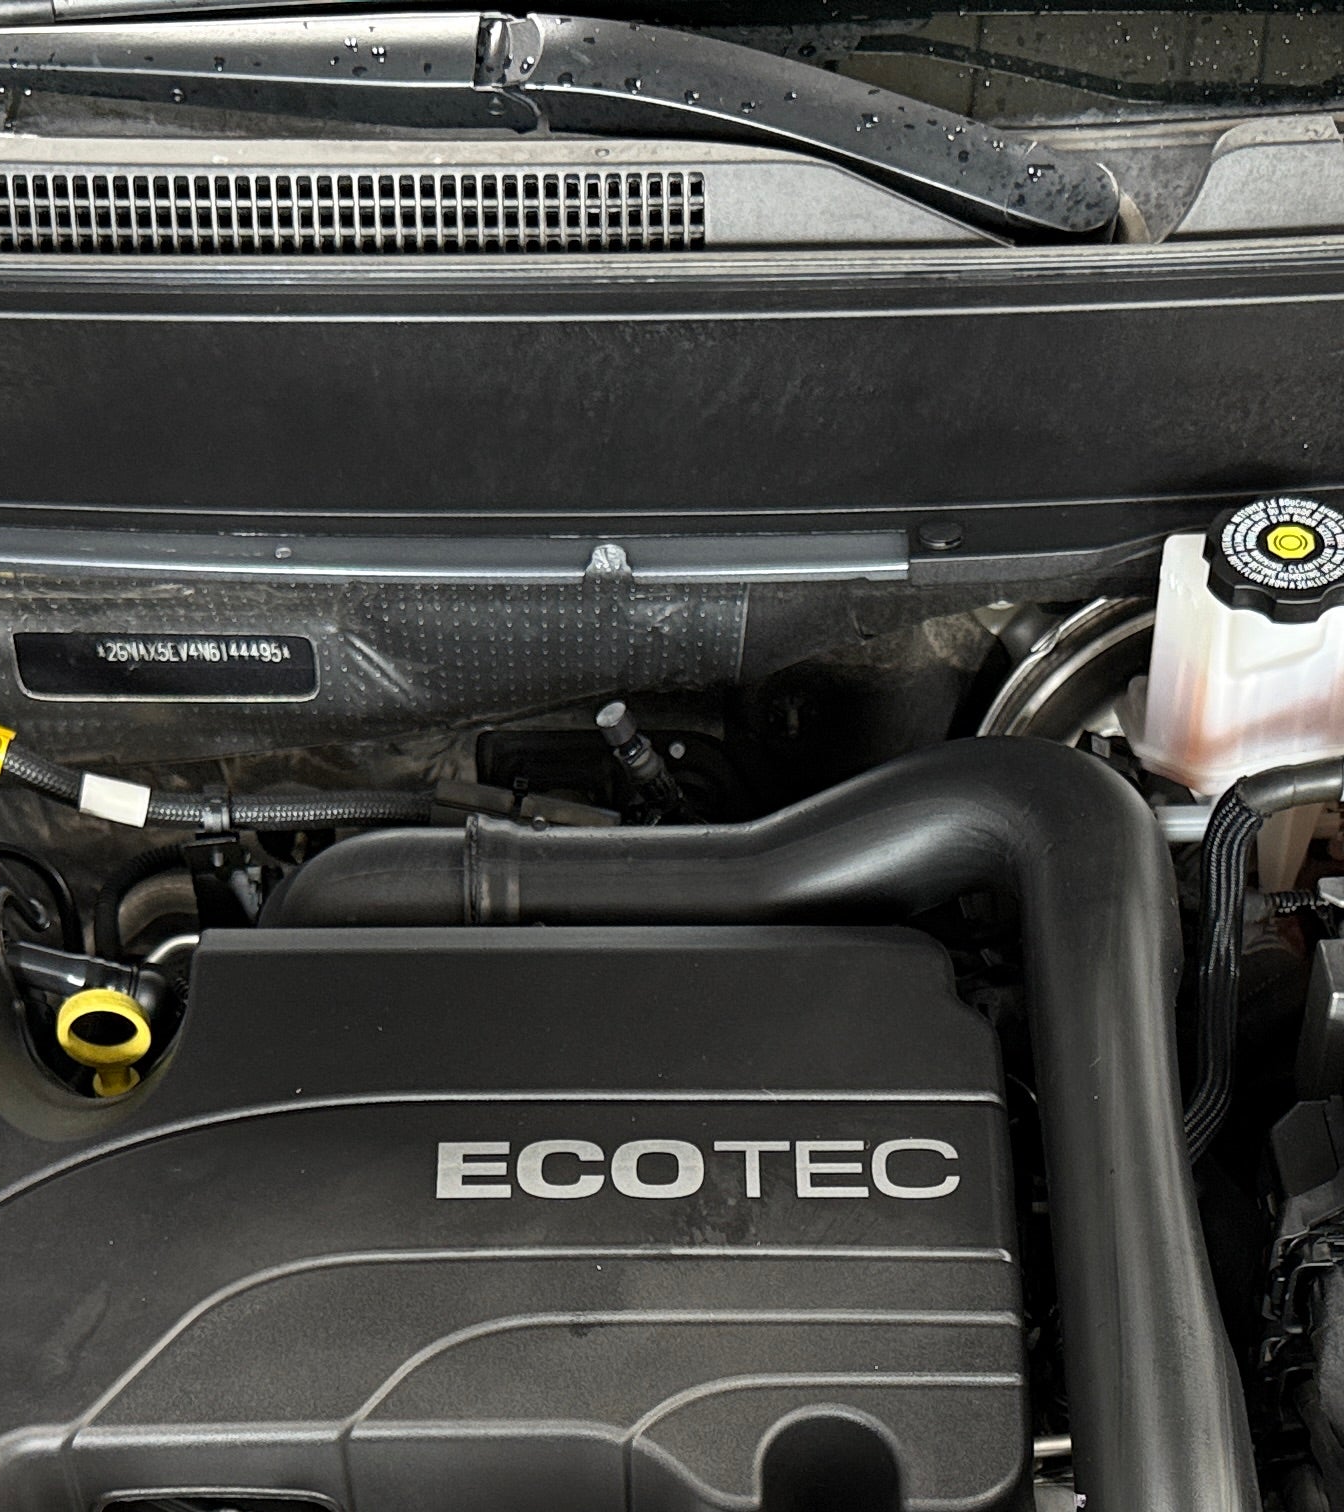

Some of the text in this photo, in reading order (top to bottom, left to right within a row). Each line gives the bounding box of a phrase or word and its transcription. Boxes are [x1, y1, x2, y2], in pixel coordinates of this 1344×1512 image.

[1238, 567, 1264, 583] FLUID
[1261, 577, 1288, 588] FROM
[1296, 575, 1327, 588] SEALED
[1287, 561, 1317, 573] CLEAN
[435, 1138, 961, 1201] ECOTEC
